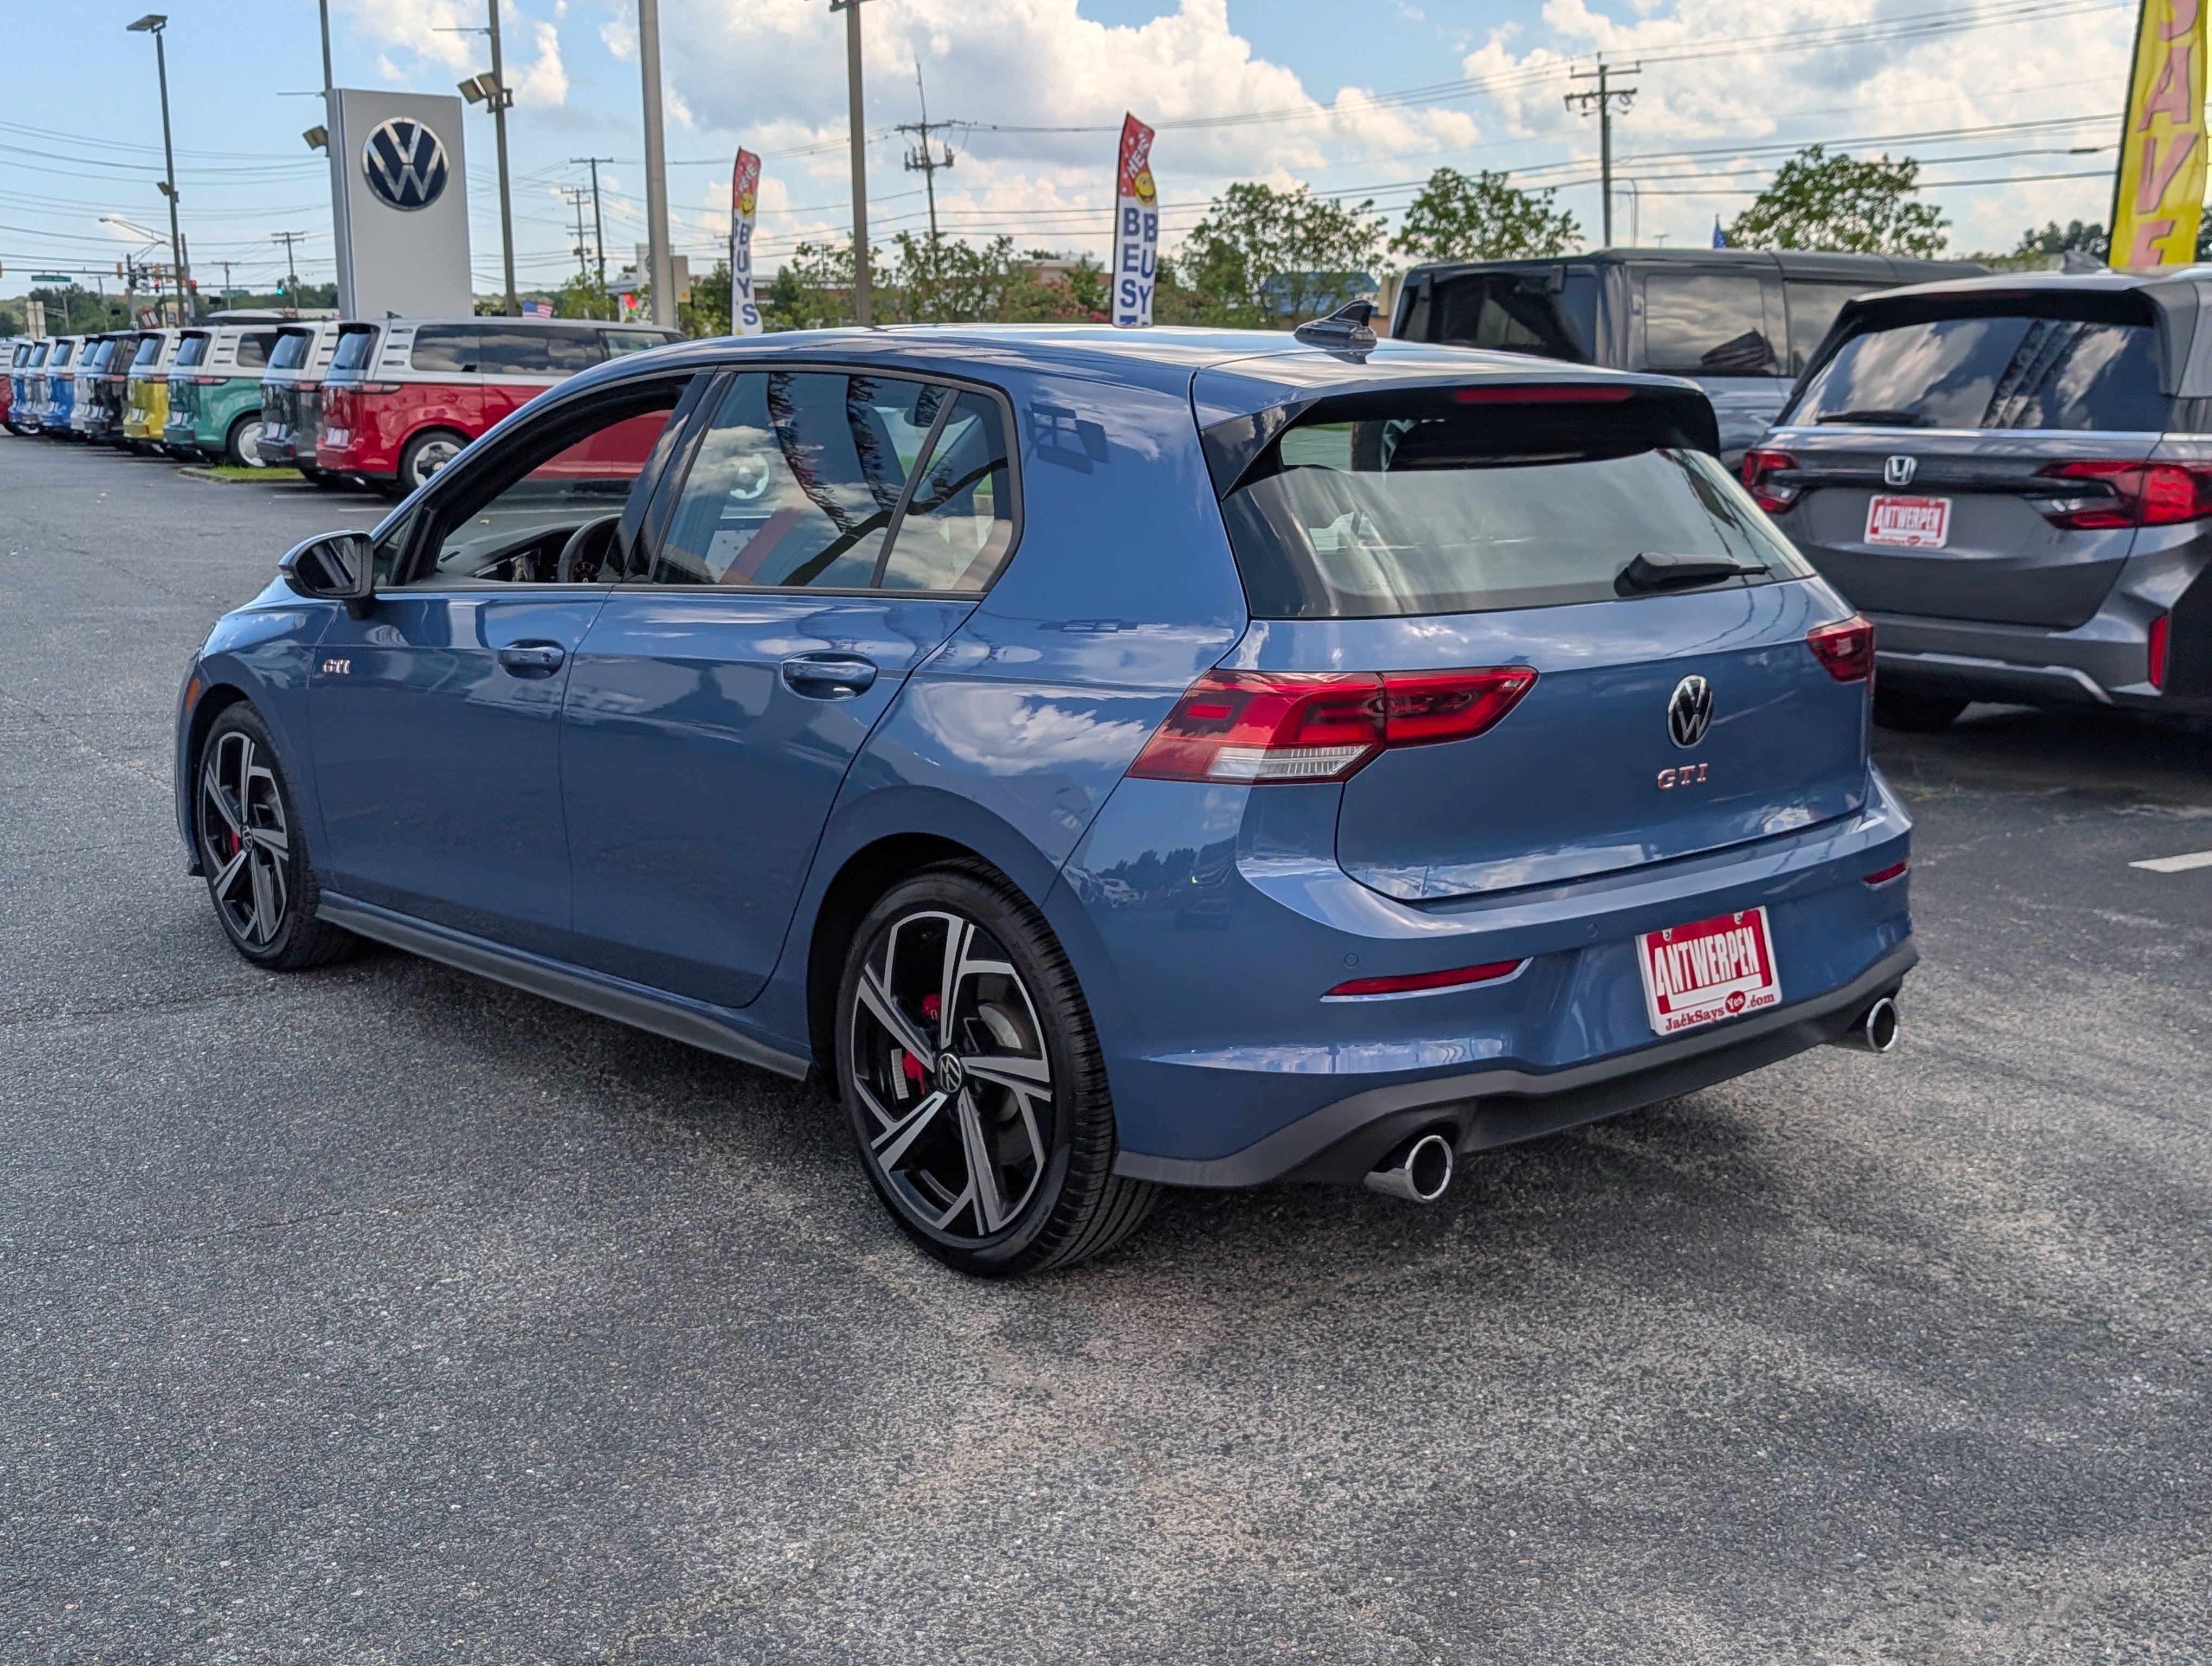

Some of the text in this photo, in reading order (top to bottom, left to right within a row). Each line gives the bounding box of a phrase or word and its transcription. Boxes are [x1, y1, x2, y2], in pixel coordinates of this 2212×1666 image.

[322, 658, 351, 674] GTI
[1657, 762, 1708, 789] GTI
[1655, 926, 1760, 996] ANTWERPEN
